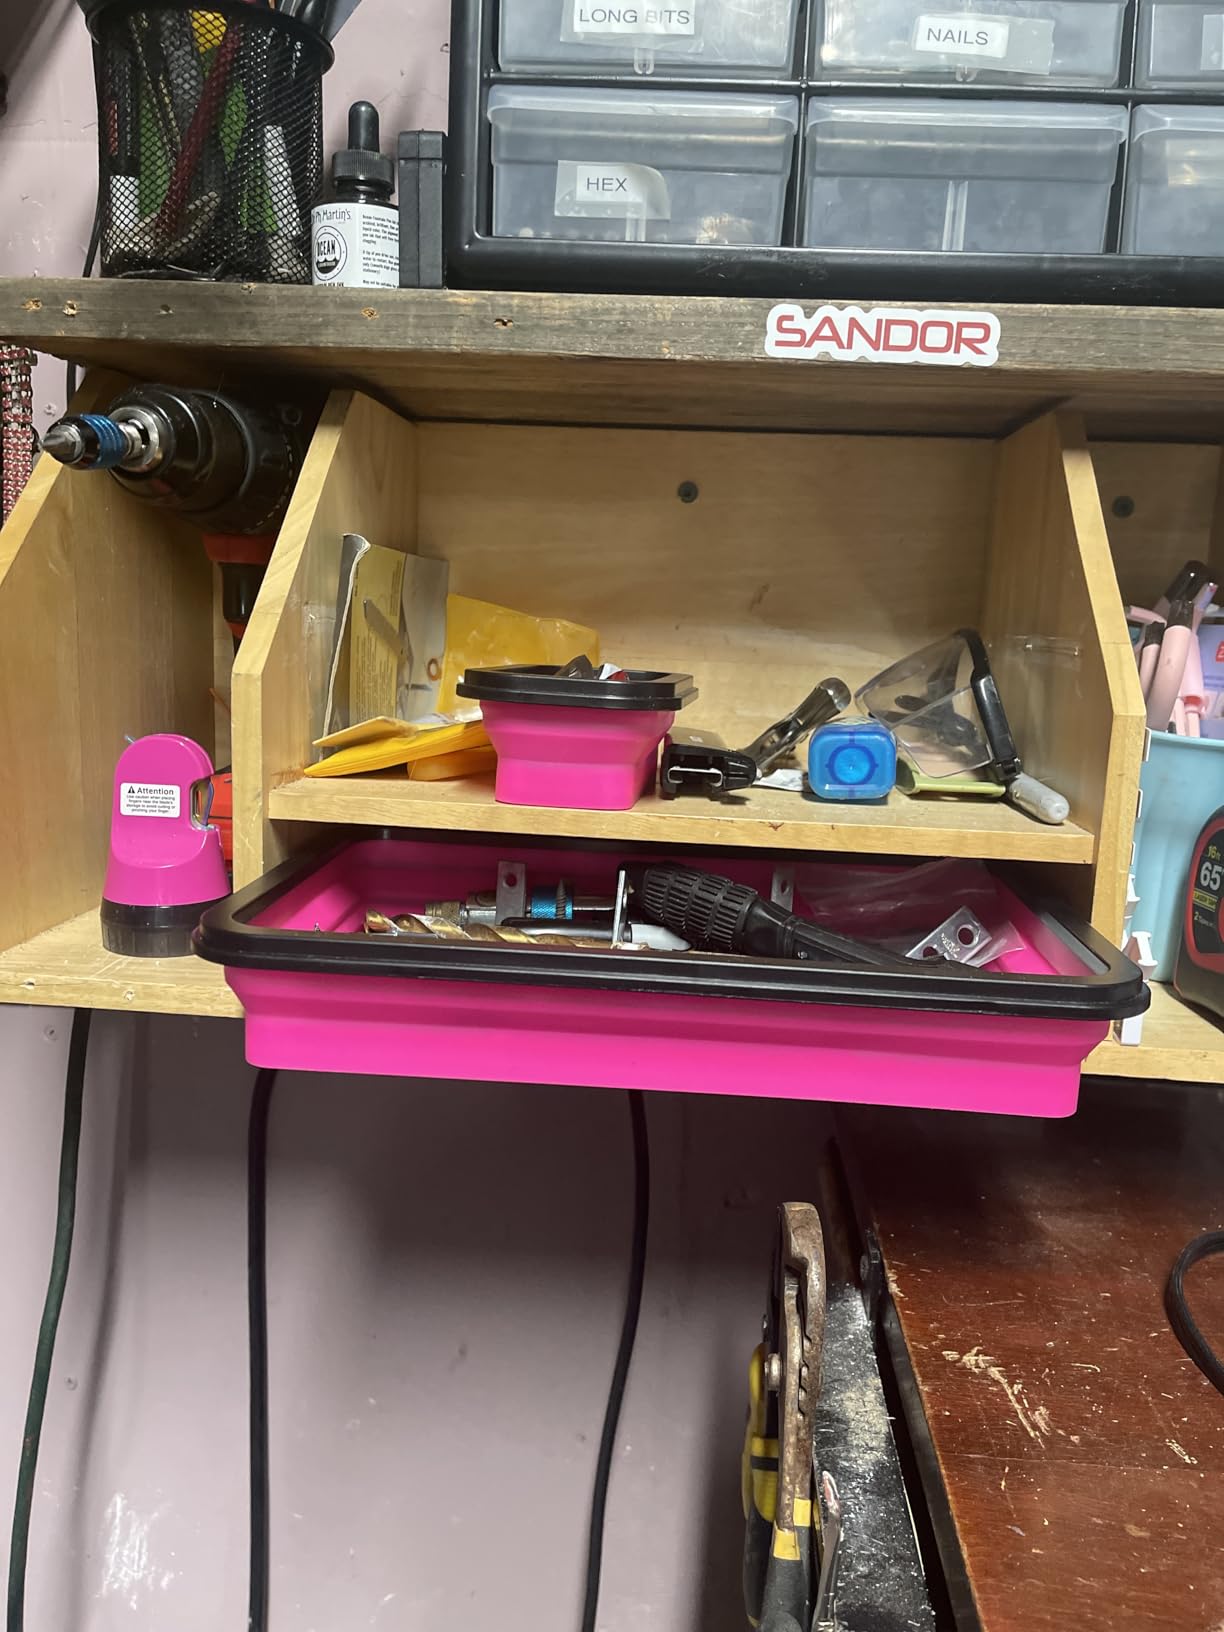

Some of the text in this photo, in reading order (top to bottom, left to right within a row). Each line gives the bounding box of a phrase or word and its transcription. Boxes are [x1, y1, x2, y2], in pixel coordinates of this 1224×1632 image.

[579, 8, 690, 25] LONG BITS
[927, 27, 989, 46] NAILS
[586, 177, 627, 192] HEX
[322, 208, 351, 221] Martin's
[774, 314, 991, 355] SANDOR
[137, 786, 174, 795] Attention
